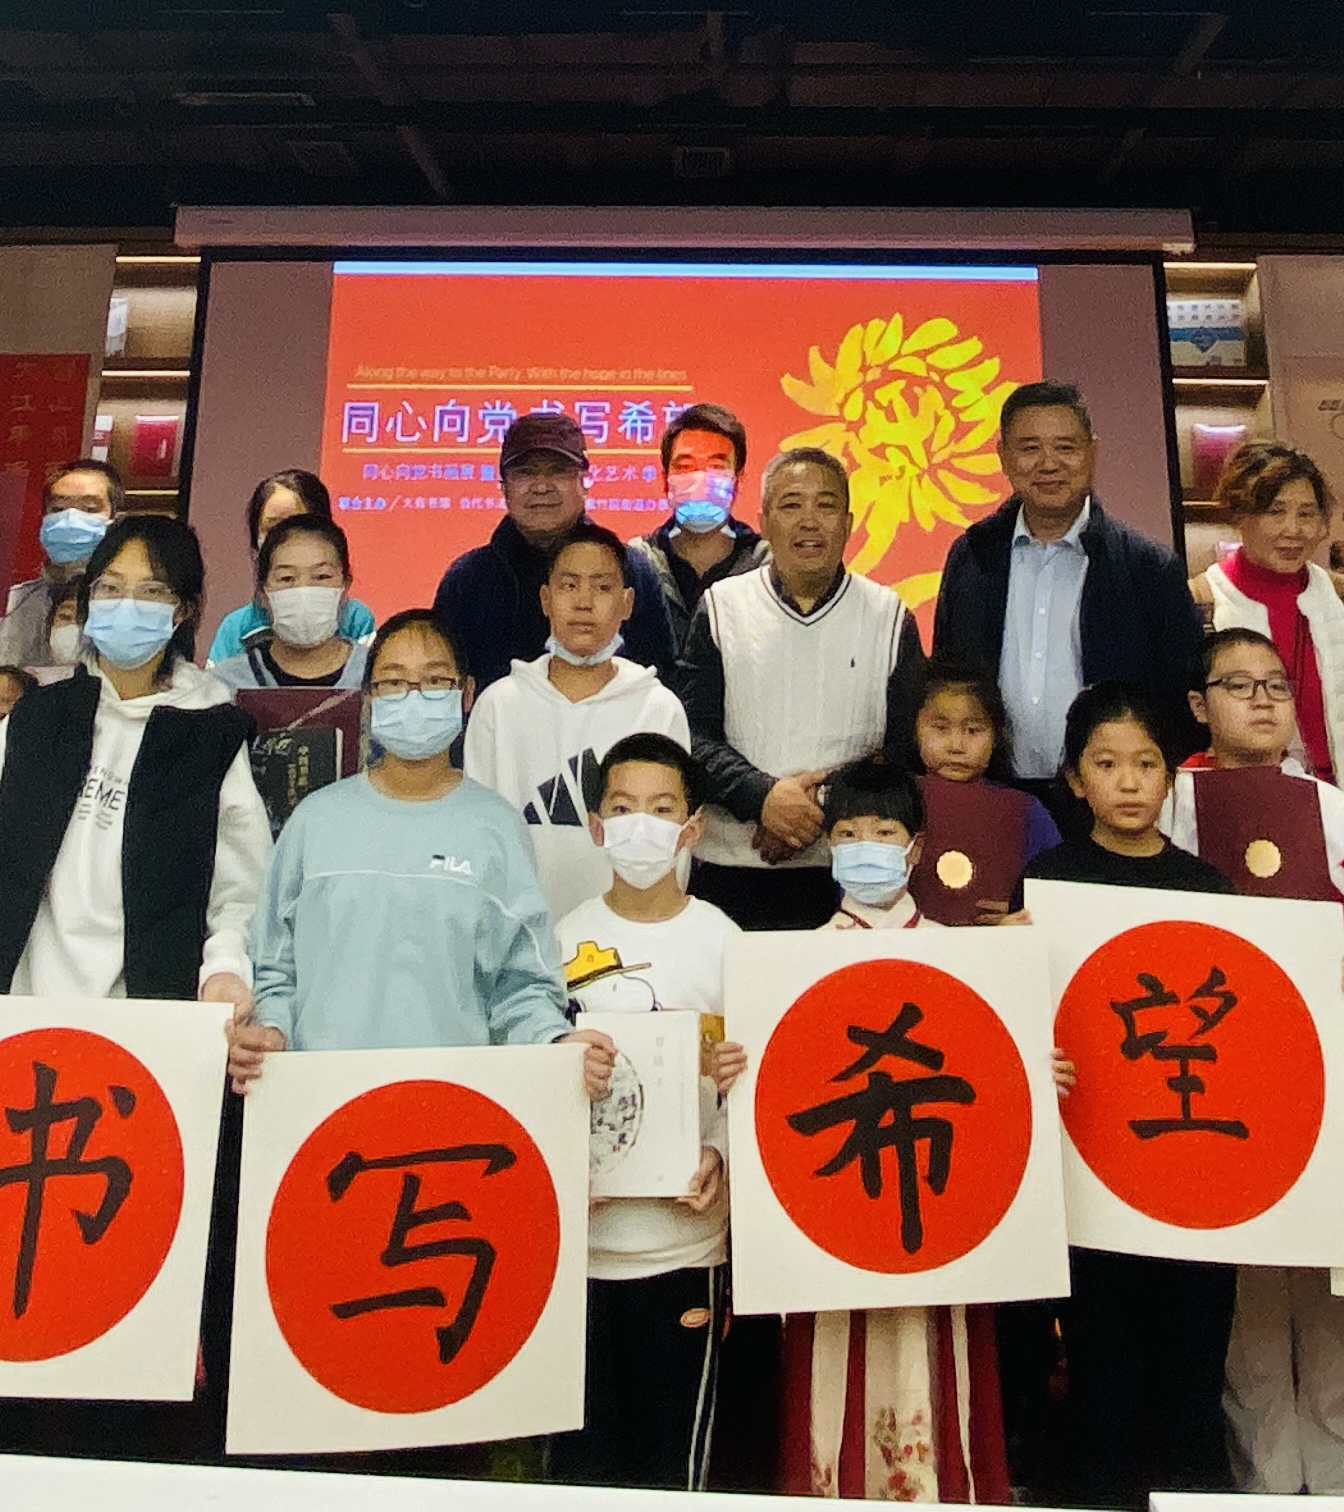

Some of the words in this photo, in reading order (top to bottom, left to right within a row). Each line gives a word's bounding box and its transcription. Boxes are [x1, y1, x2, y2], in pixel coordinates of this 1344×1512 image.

[429, 854, 475, 876] FILA
[785, 1001, 978, 1256] 希
[1109, 966, 1250, 1141] 望
[325, 1142, 518, 1366] 写
